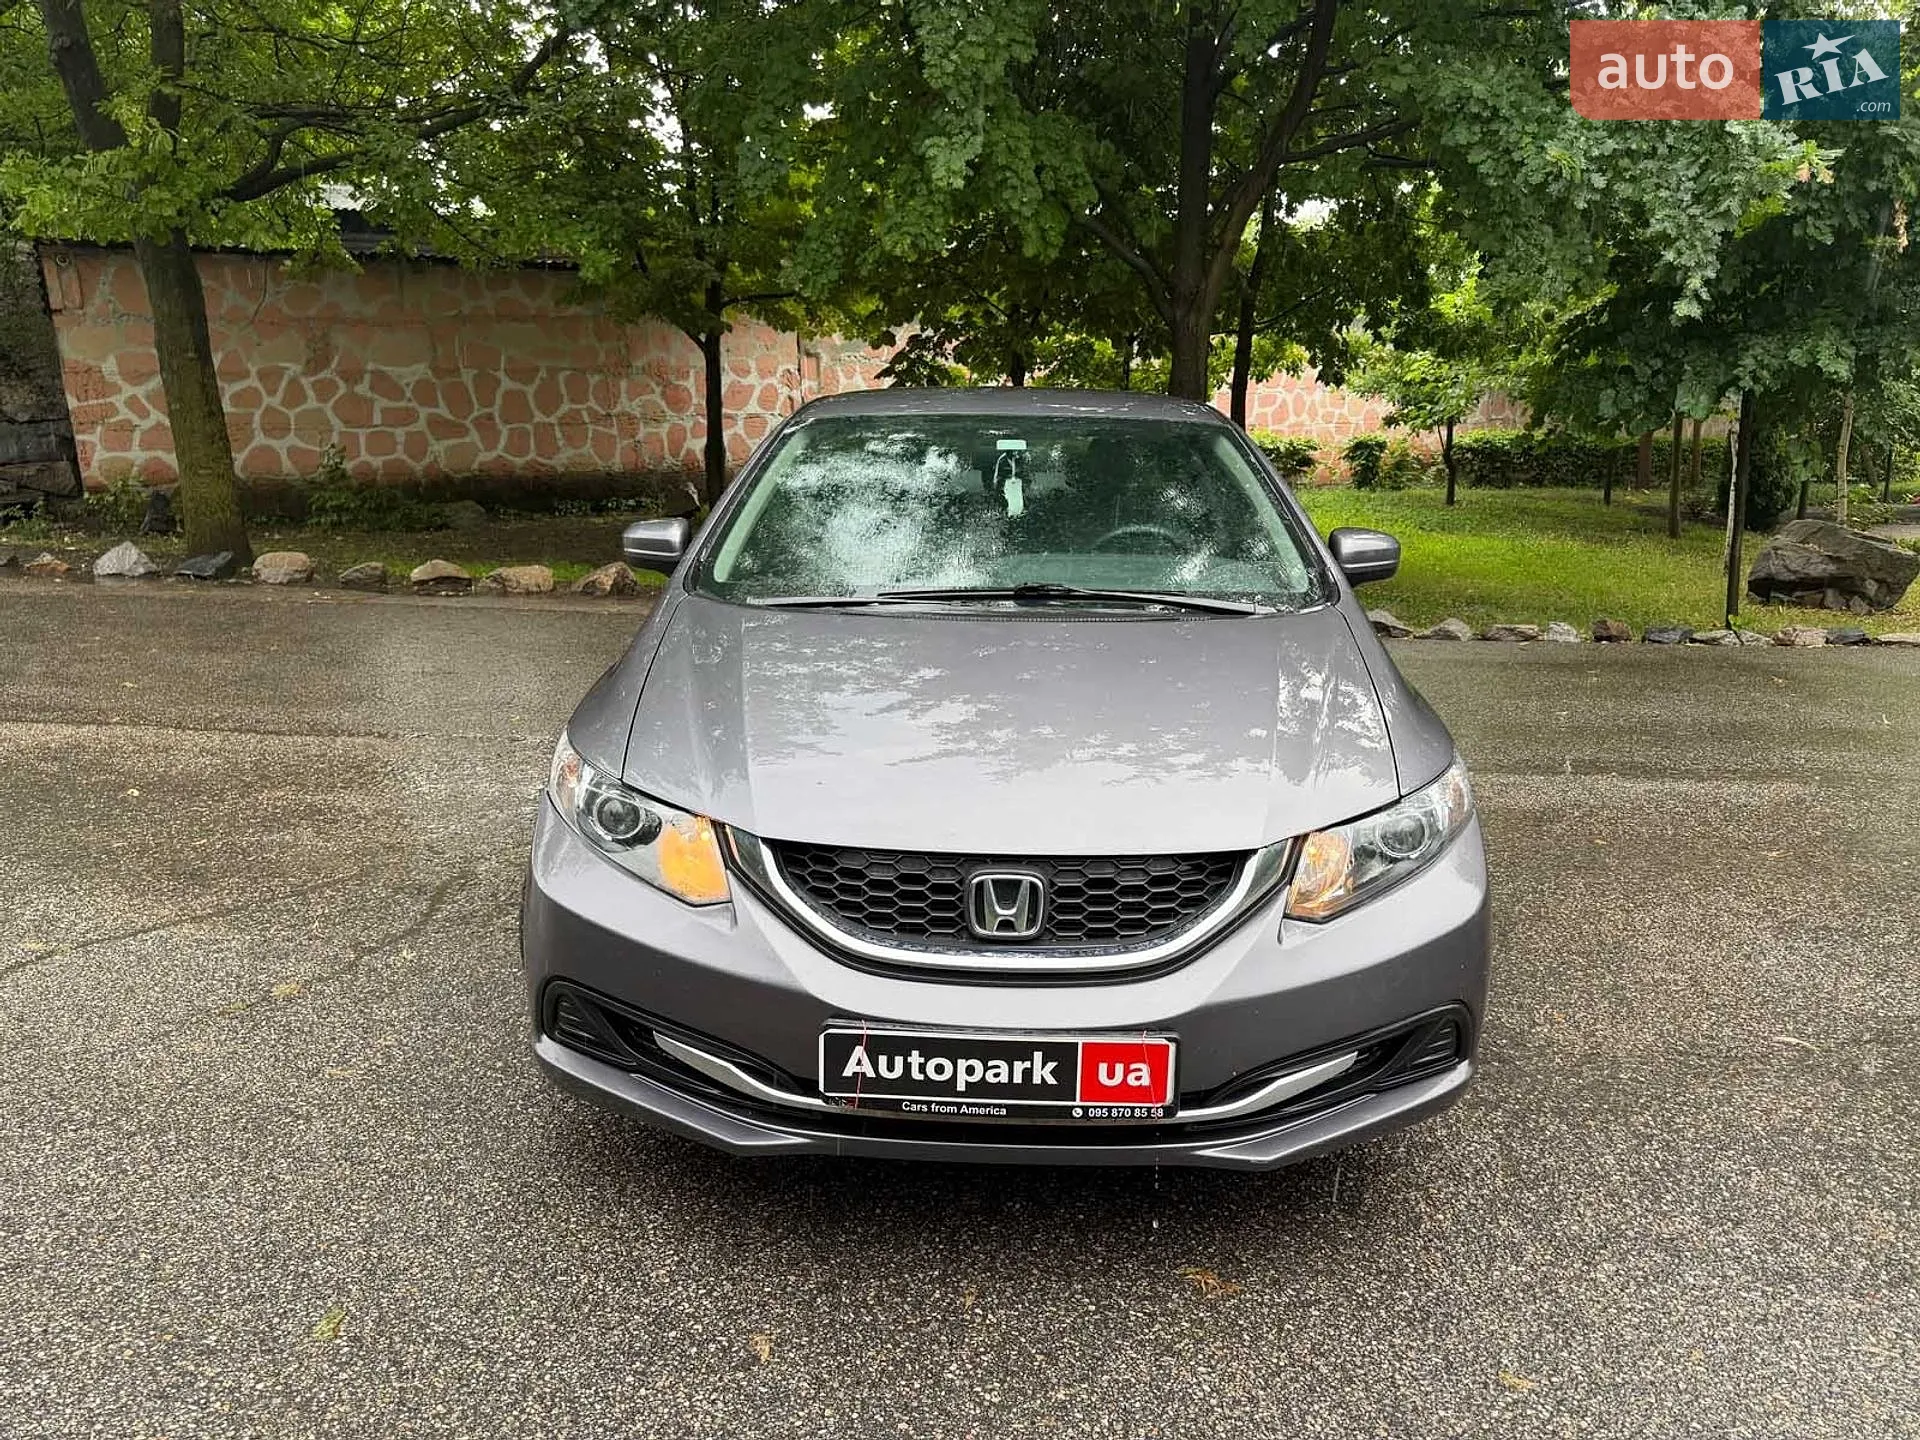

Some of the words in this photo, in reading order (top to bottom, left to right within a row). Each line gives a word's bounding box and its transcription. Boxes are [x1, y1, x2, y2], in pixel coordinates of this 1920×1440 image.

[842, 1045, 1058, 1092] Autopark
[1098, 1060, 1151, 1087] ua
[902, 1101, 928, 1112] Cars
[931, 1103, 957, 1114] from
[960, 1104, 1007, 1115] America
[1088, 1108, 1109, 1118] 095
[1111, 1108, 1132, 1118] 870
[1134, 1108, 1148, 1118] 85
[1150, 1108, 1164, 1119] 58
